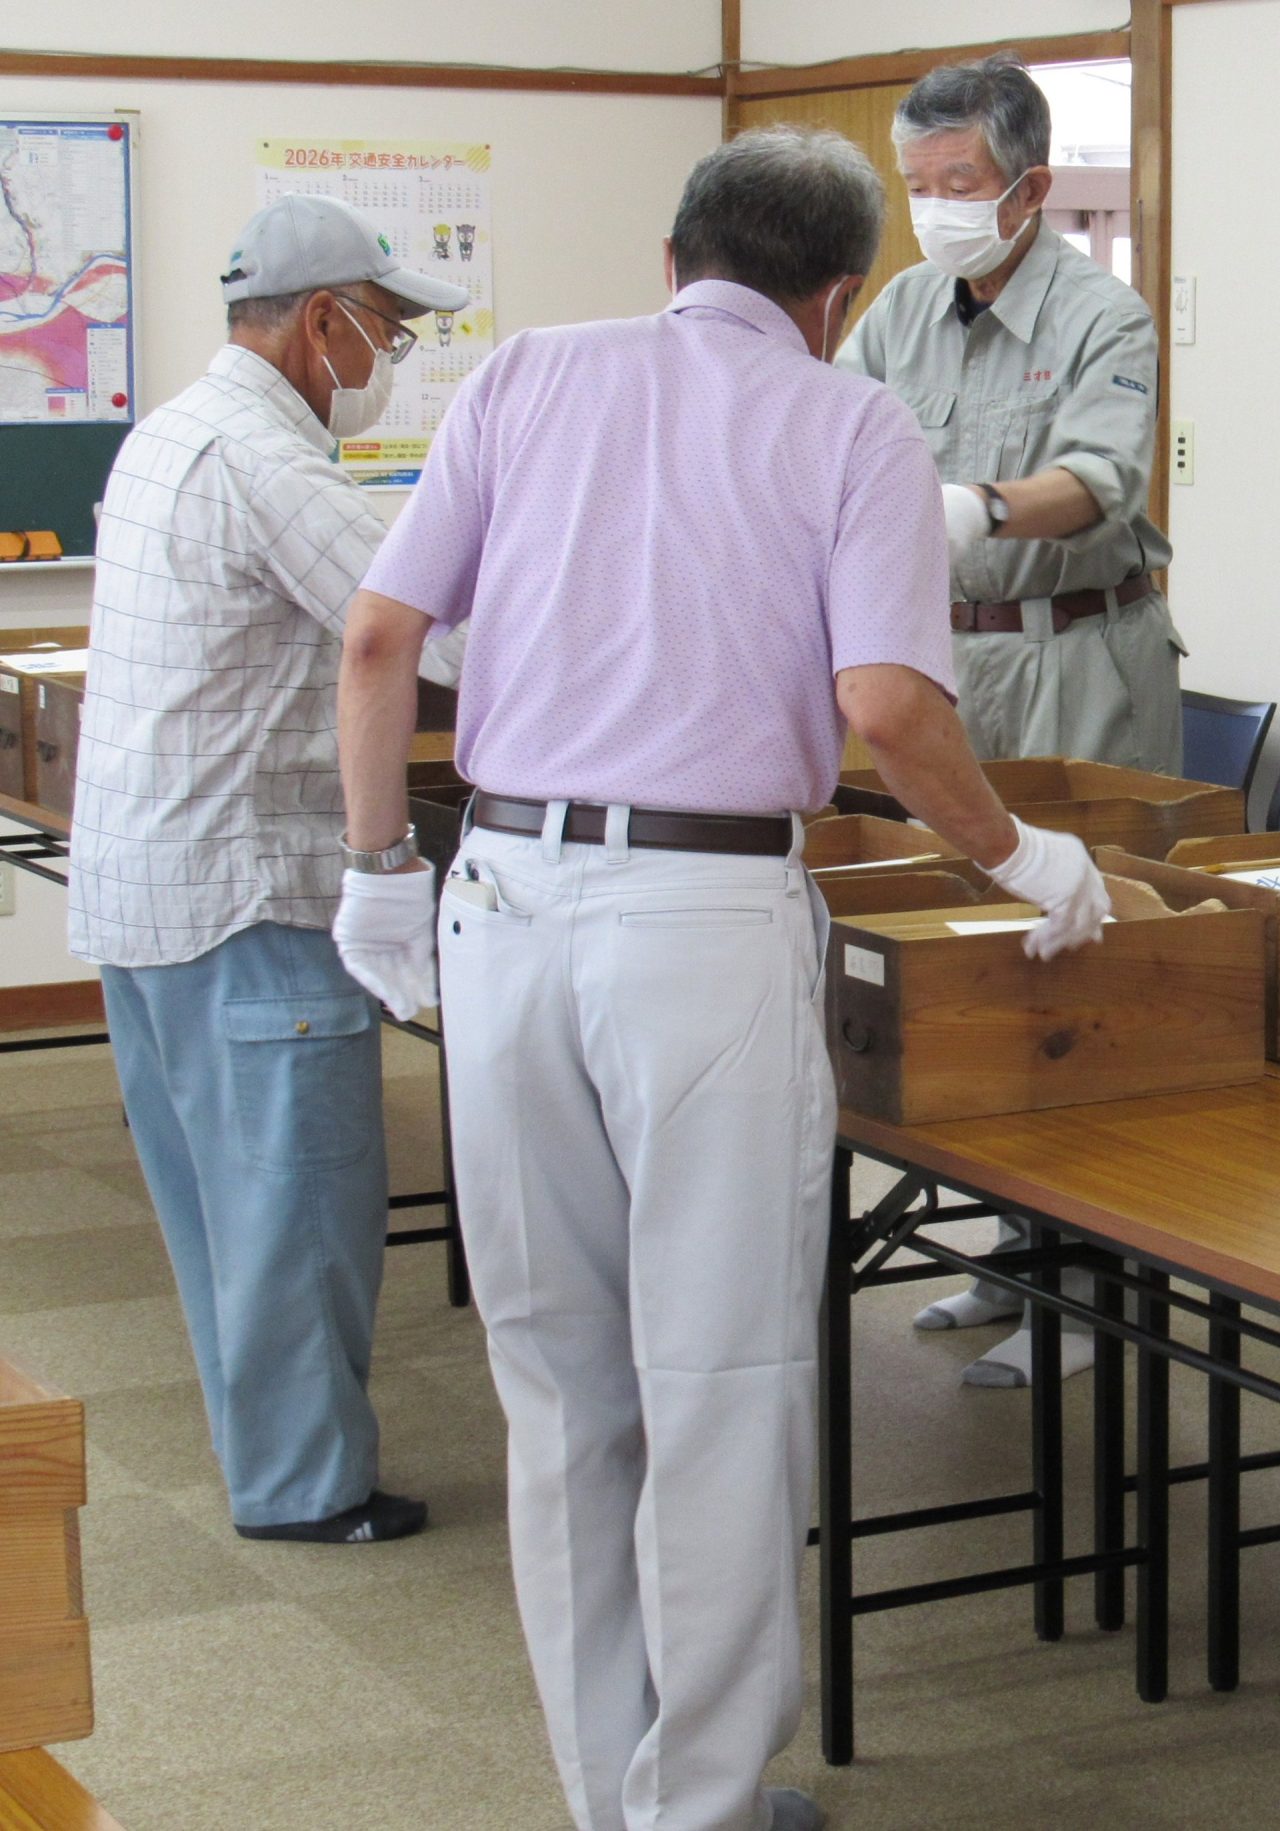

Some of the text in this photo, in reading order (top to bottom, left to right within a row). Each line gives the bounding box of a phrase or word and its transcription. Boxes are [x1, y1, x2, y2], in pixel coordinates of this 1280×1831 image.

[285, 149, 466, 171] 2026年 交通安全カレンダー
